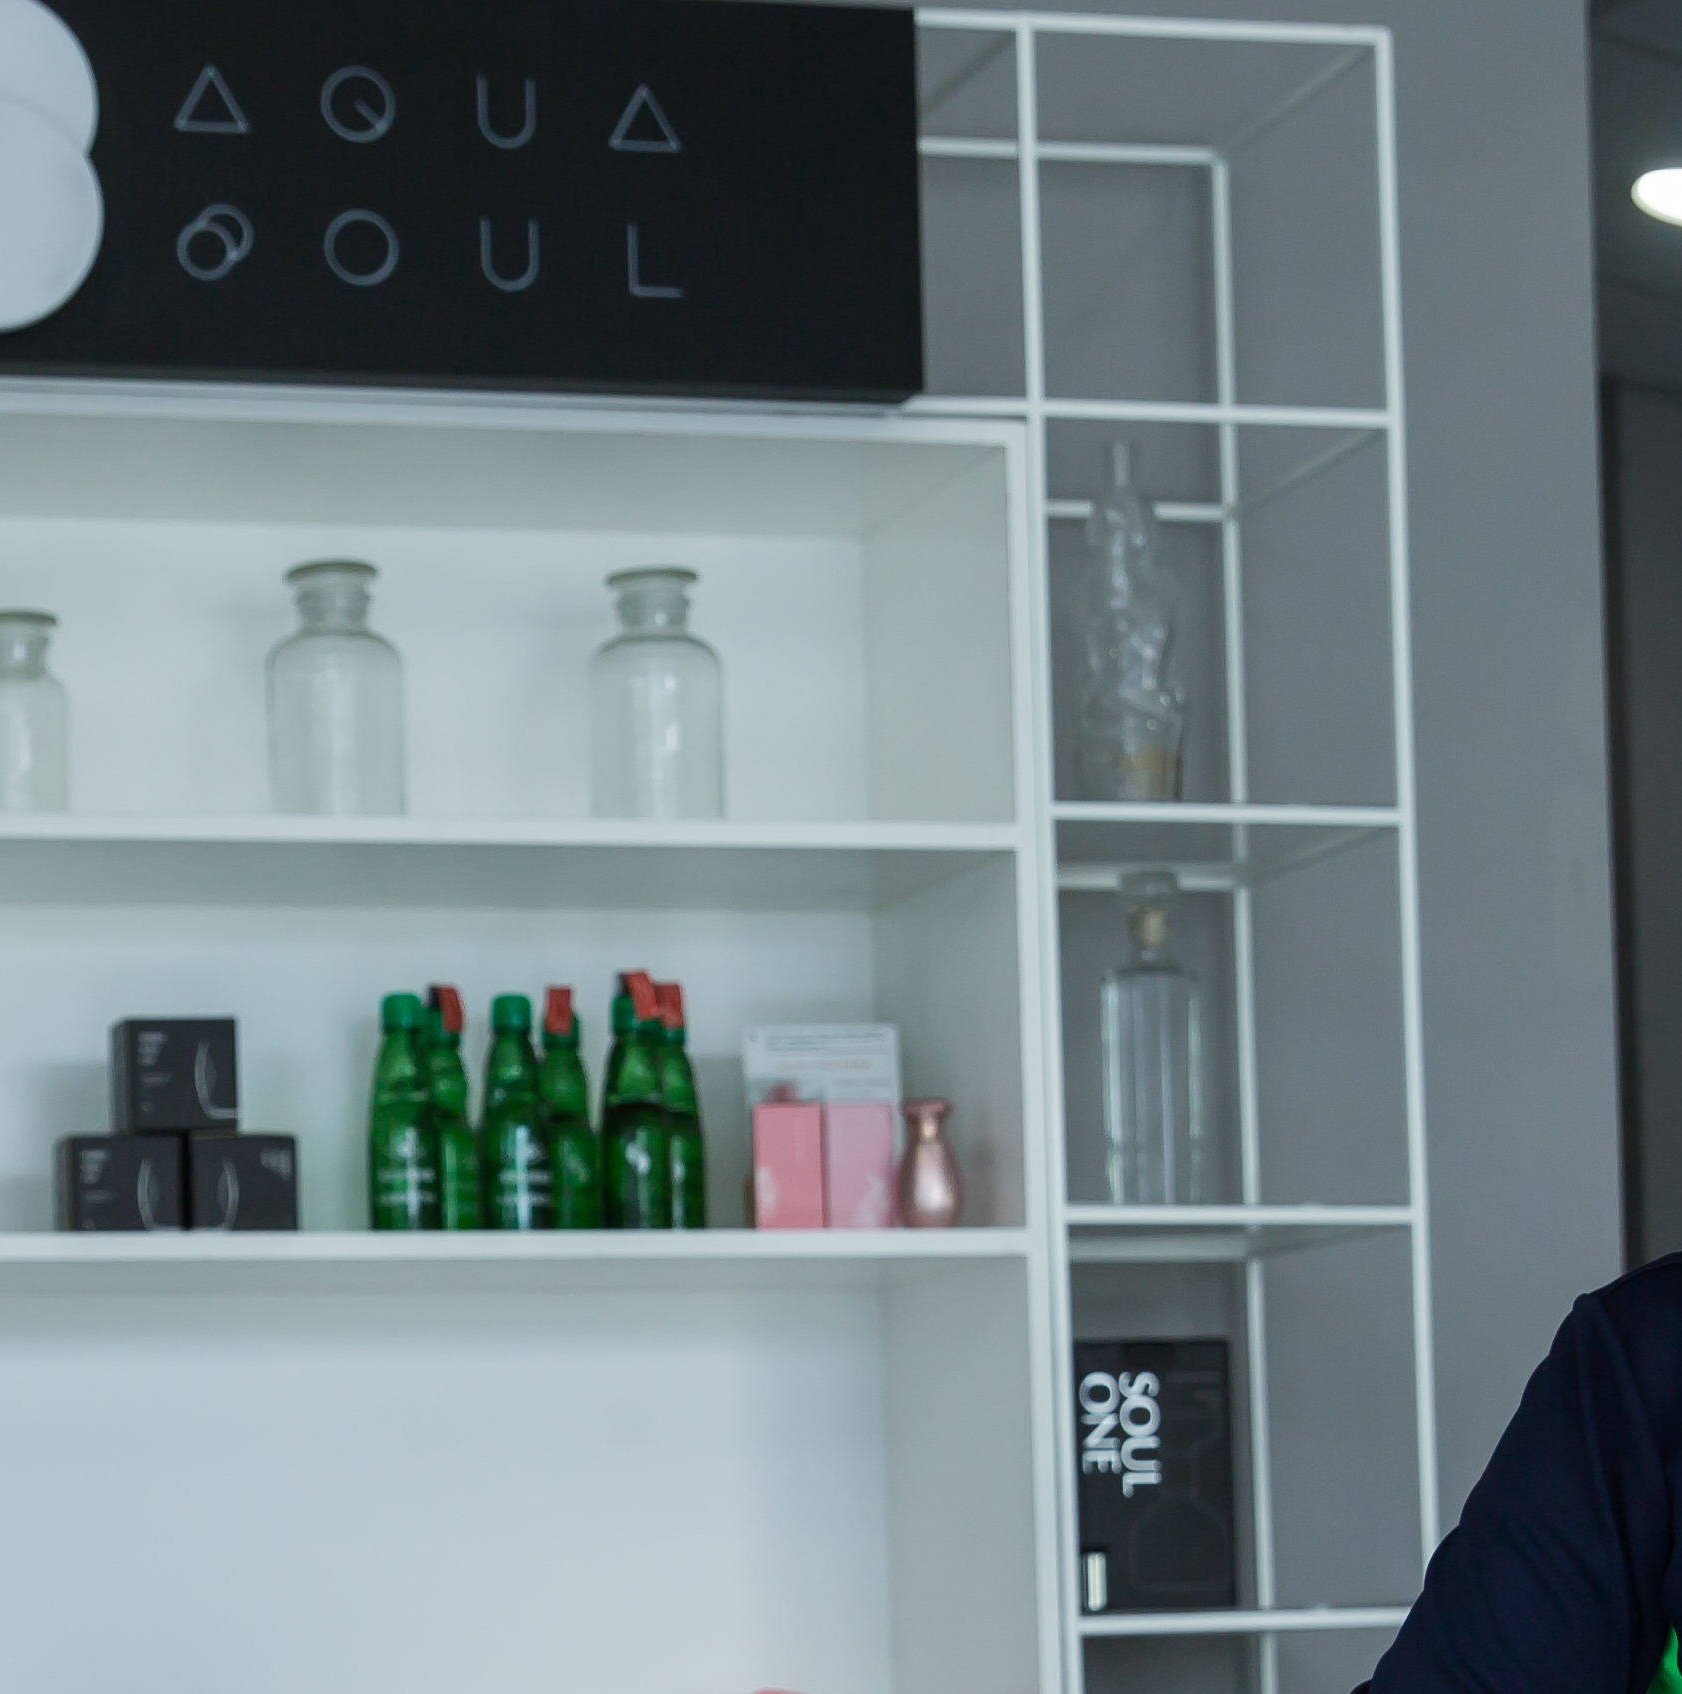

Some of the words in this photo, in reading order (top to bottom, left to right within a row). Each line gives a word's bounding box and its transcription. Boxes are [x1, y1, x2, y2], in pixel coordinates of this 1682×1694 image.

[174, 63, 682, 153] AQUA
[1079, 1371, 1121, 1475] ONE
[1118, 1371, 1162, 1498] SOUL
